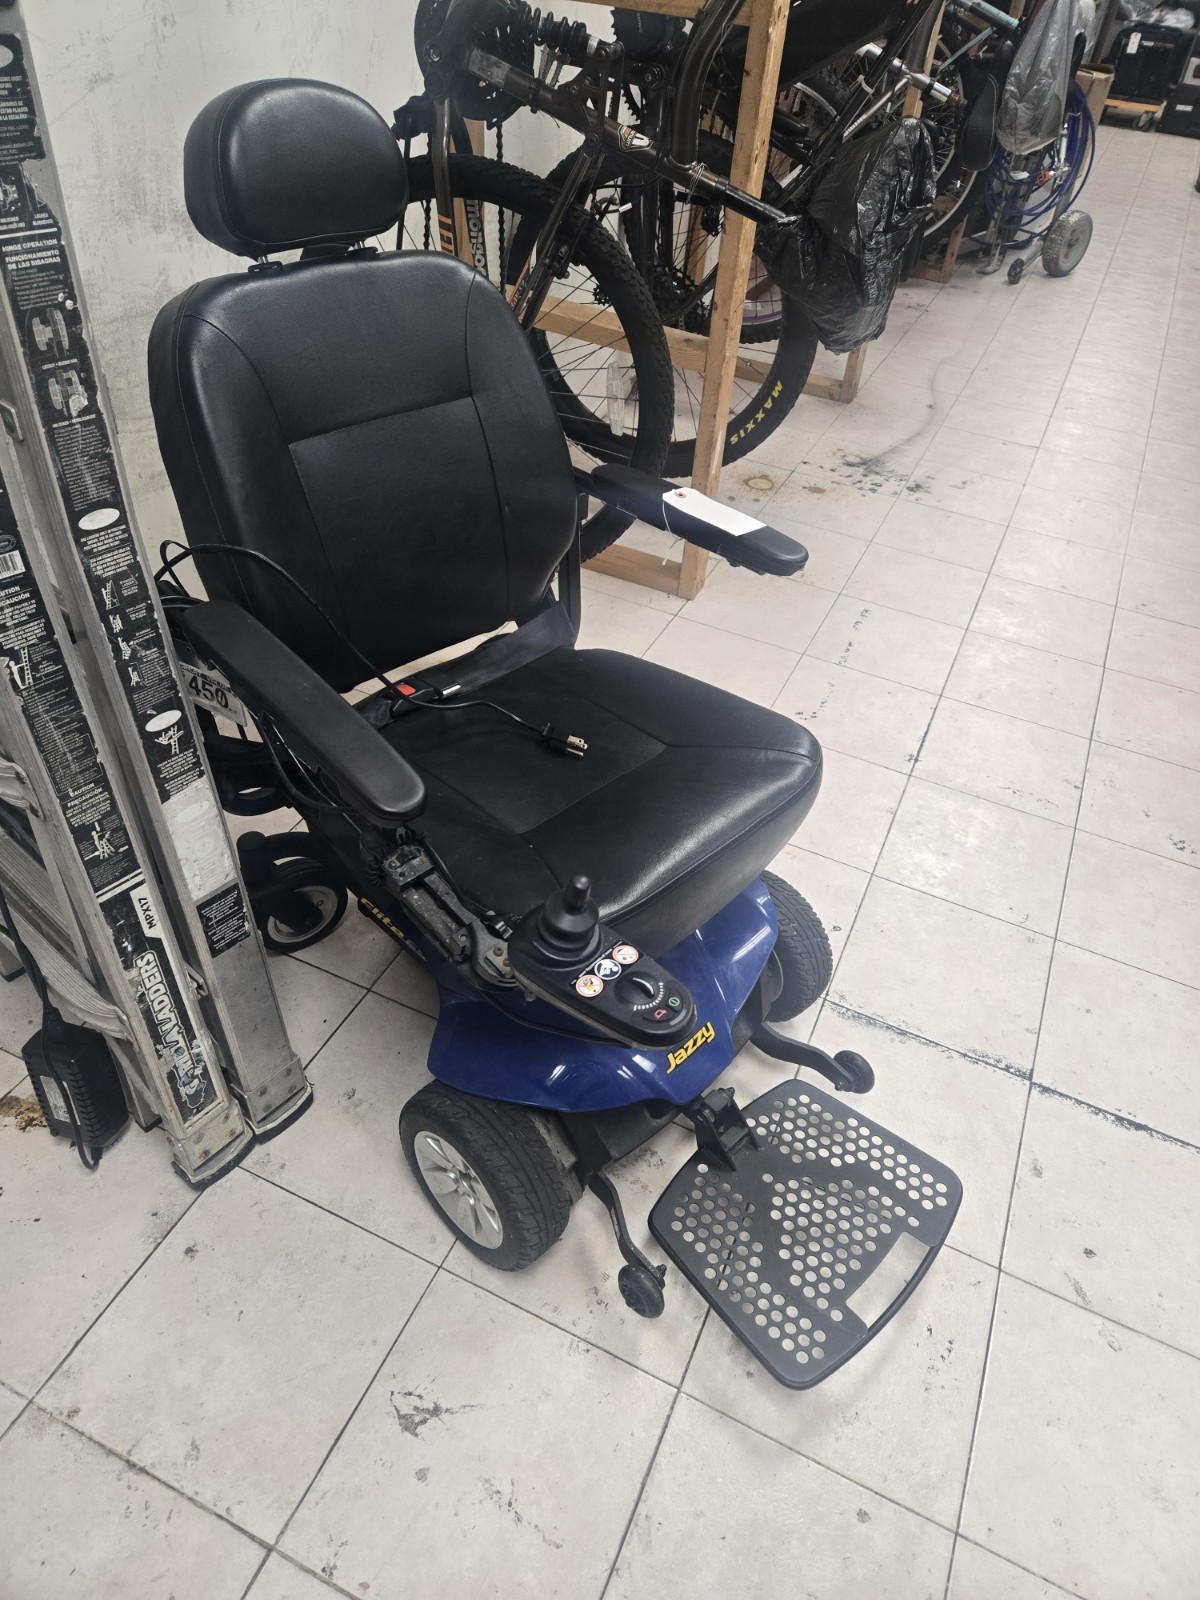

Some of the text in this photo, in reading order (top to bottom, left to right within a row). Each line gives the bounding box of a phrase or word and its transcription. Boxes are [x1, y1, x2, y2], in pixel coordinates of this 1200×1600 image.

[5, 249, 60, 263] FUNCIONAMIENTO
[22, 238, 58, 249] OPERATION
[730, 380, 783, 445] MAXXIS
[0, 585, 20, 597] UTION
[0, 592, 31, 607] CAUCIÓN
[189, 675, 229, 709] 450
[68, 782, 95, 798] CAUTION
[138, 896, 157, 930] MPX17
[136, 950, 178, 1030] LADDERS
[666, 1021, 716, 1075] Jazzy
